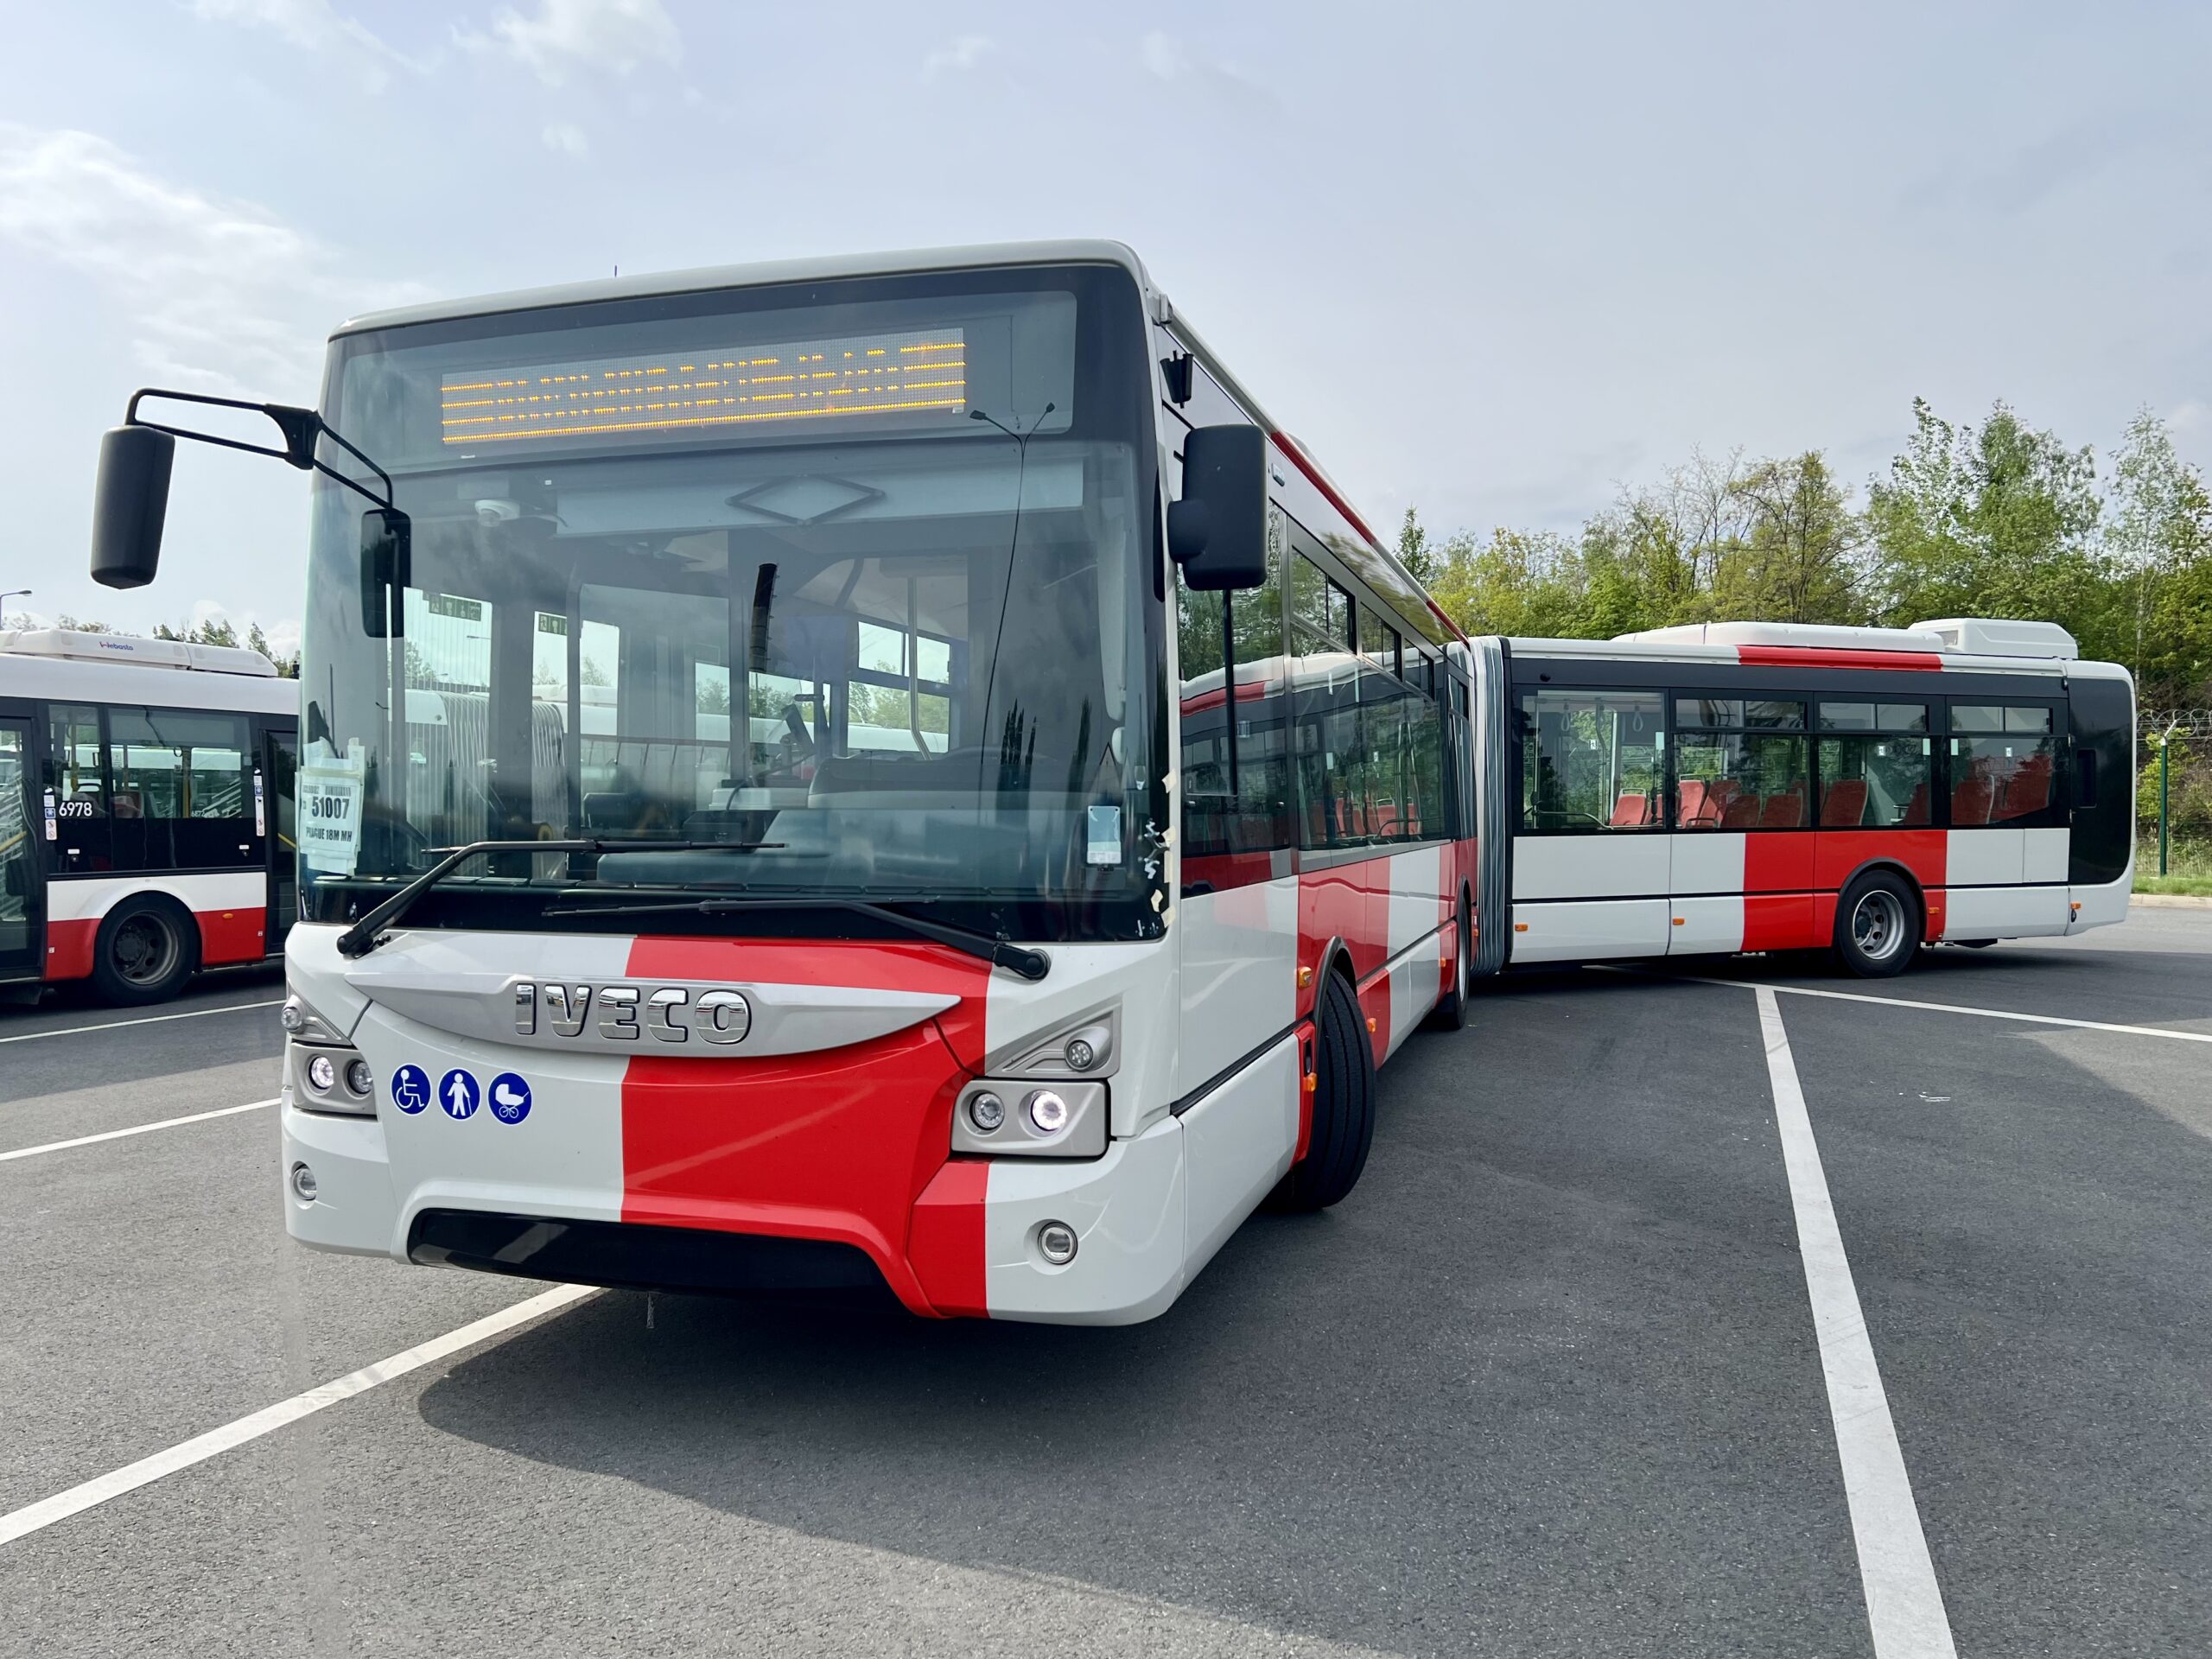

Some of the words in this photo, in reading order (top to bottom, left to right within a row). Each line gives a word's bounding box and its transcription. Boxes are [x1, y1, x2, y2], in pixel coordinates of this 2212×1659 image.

[99, 640, 134, 652] Webasto
[59, 802, 92, 817] 6978
[311, 796, 350, 819] 51007
[326, 829, 340, 842] 18M
[515, 982, 752, 1045] IVECO
